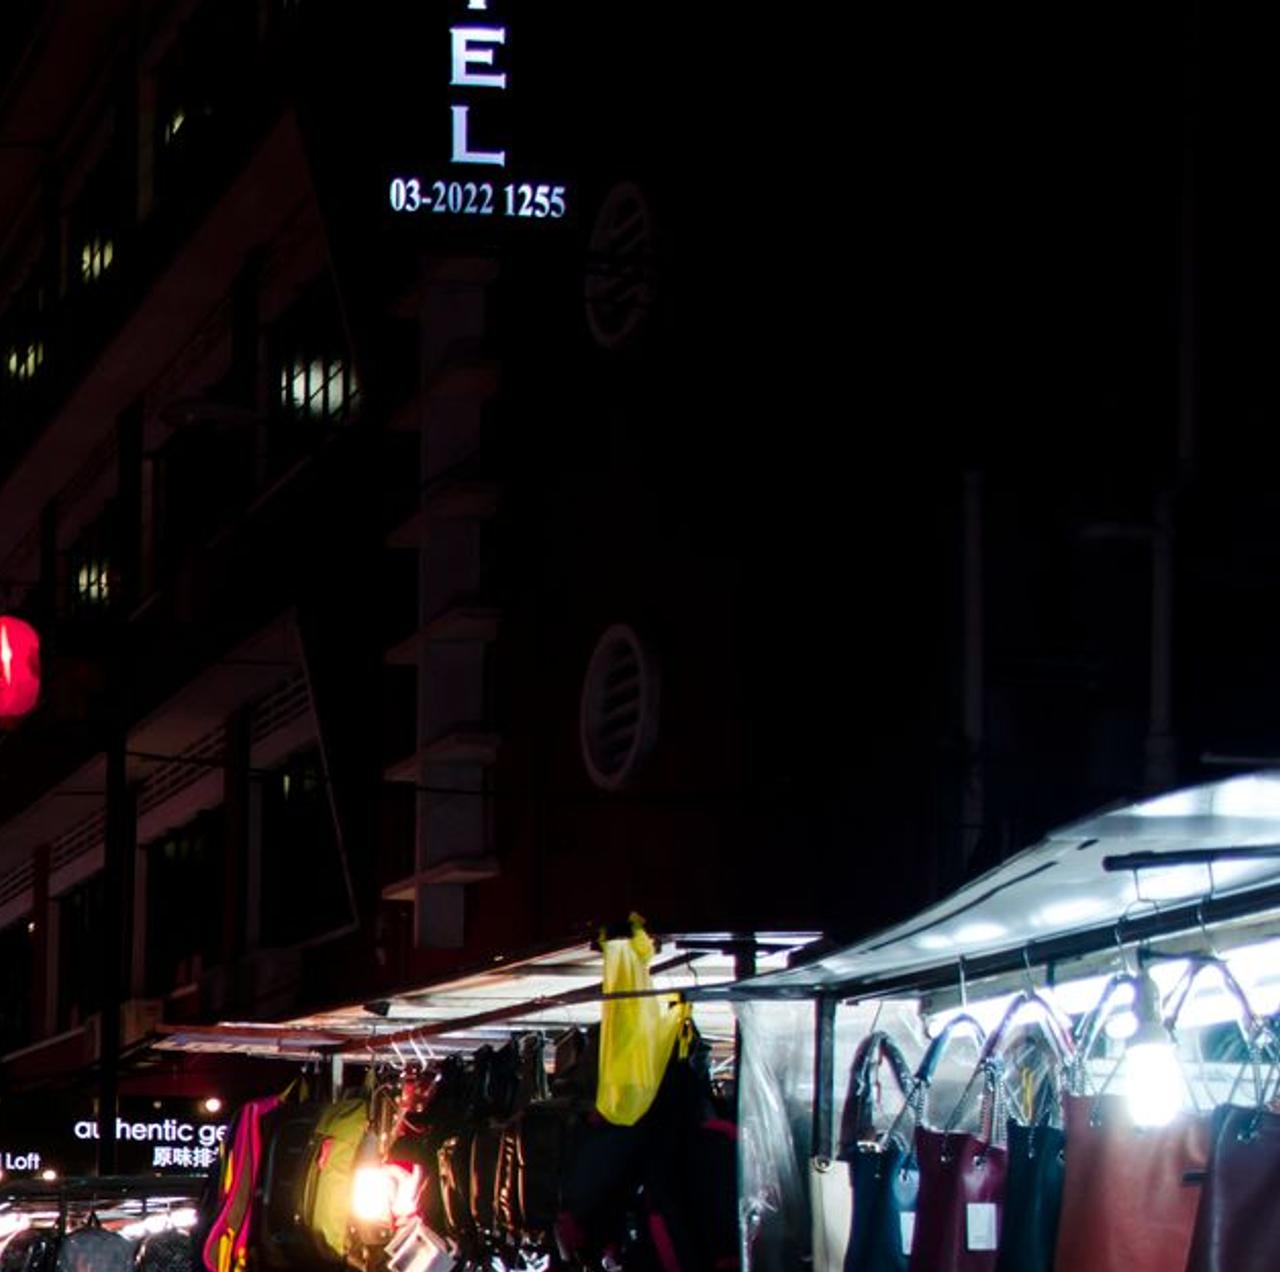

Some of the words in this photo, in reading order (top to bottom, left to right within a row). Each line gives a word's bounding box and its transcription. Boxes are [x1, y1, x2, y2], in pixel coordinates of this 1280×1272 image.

[449, 0, 506, 167] EL
[390, 178, 494, 215] 03-2022
[504, 183, 566, 218] 1255
[74, 1117, 194, 1142] auhentic
[6, 1152, 41, 1171] Loft
[152, 1146, 219, 1168] 原味排
